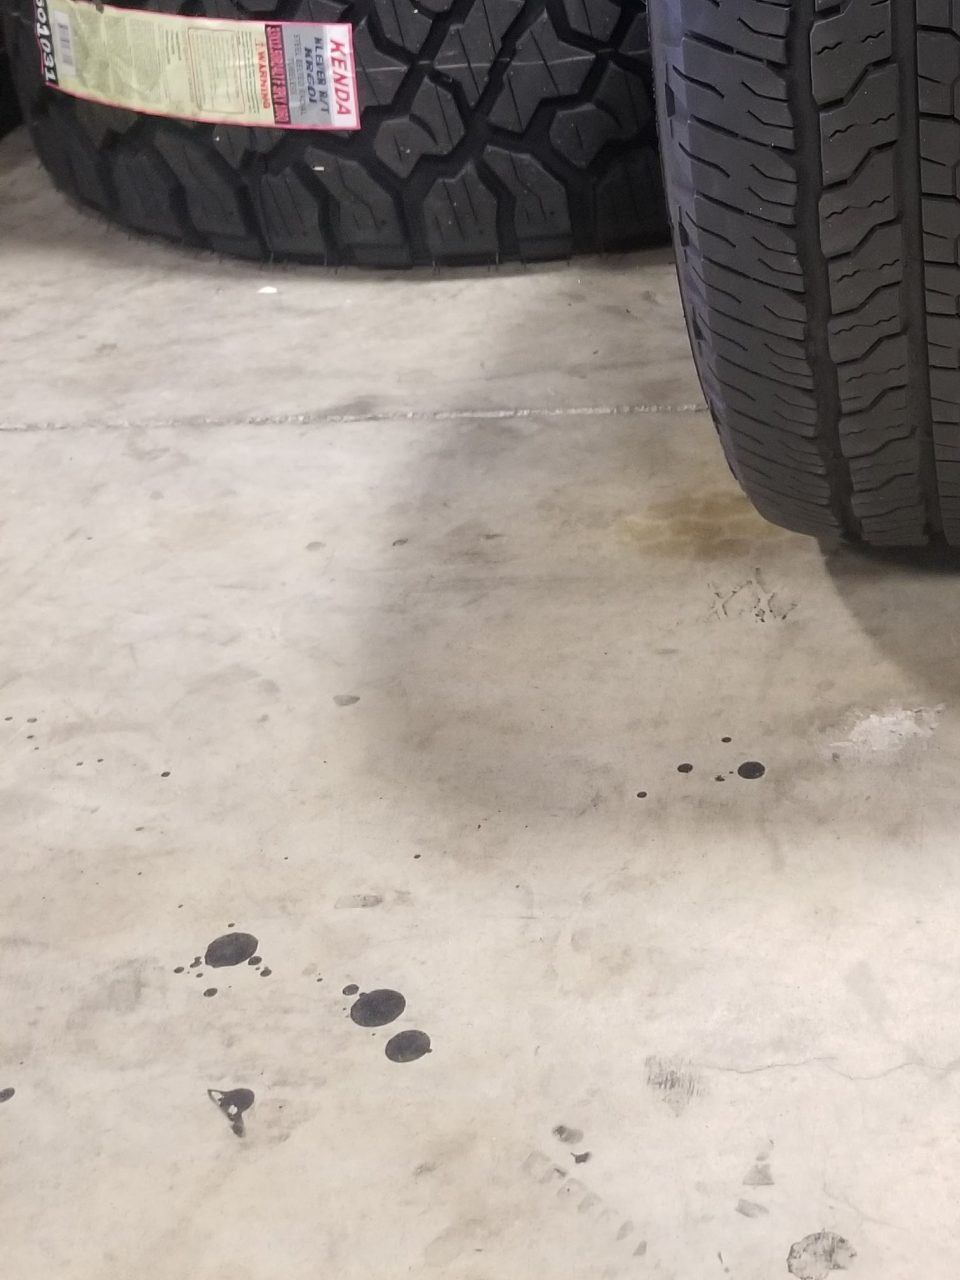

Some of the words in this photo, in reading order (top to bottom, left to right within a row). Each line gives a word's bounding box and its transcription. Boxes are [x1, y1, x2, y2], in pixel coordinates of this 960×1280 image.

[257, 52, 271, 109] WARNING
[304, 46, 317, 104] KR601
[314, 37, 327, 85] KLEVER
[330, 39, 352, 115] KENDA
[319, 91, 329, 115] R/T
